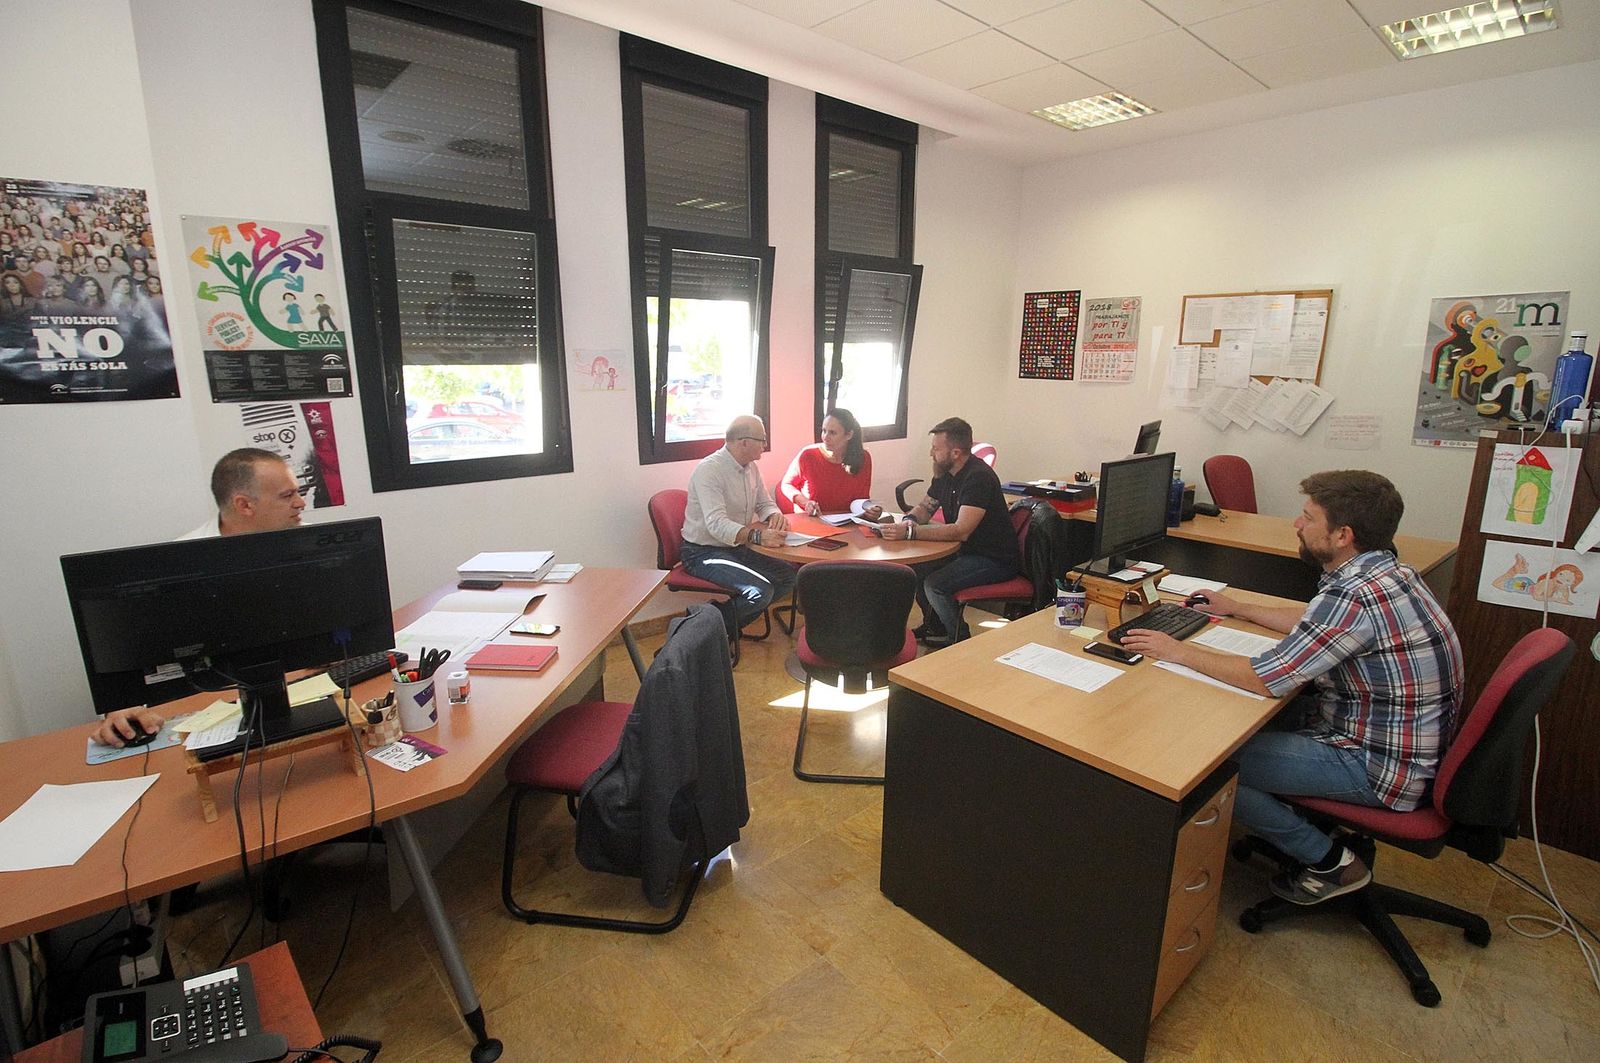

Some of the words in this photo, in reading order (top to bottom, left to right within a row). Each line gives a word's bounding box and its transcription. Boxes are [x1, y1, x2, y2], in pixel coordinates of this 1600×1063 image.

[1089, 303, 1112, 312] 2018
[1496, 297, 1516, 313] 21
[1513, 302, 1561, 327] m
[50, 316, 119, 325] VIOLENCIA
[1091, 322, 1108, 331] por
[1120, 322, 1128, 330] y
[298, 333, 342, 344] SAVA
[1092, 333, 1113, 341] para
[32, 328, 125, 358] NO
[41, 361, 87, 371] ESTÁS
[90, 362, 128, 370] SOLA
[252, 432, 276, 443] stop
